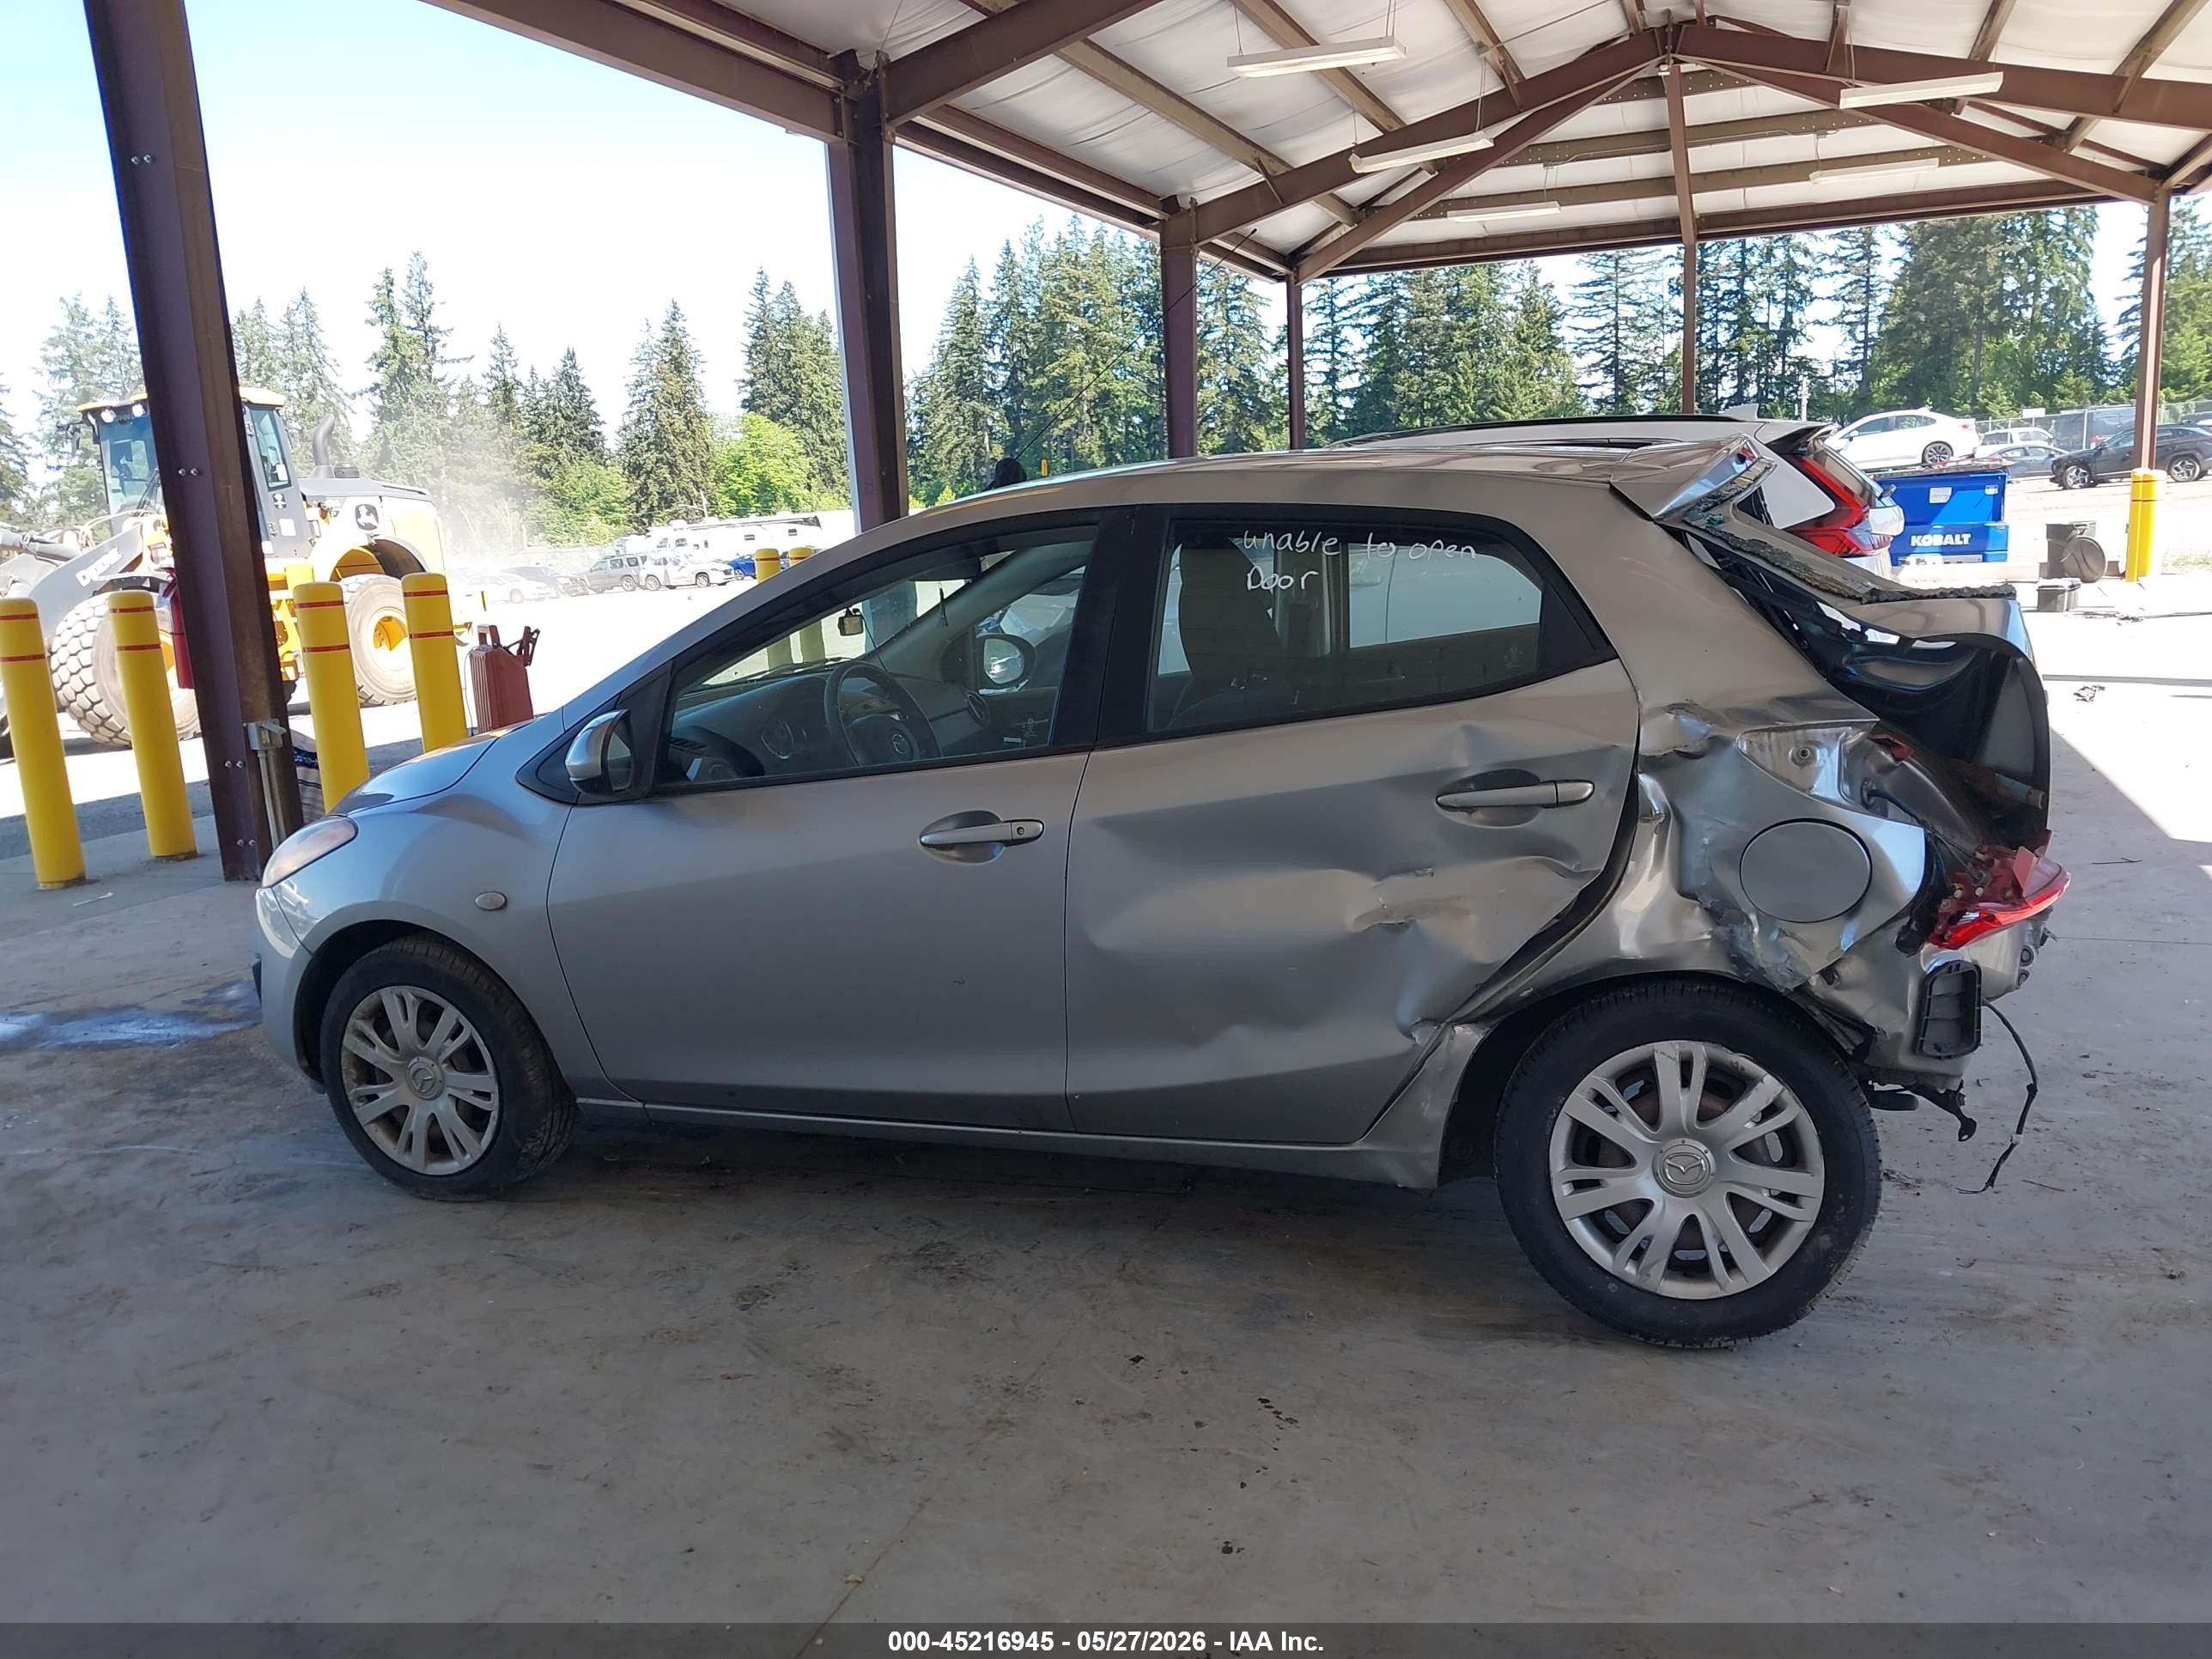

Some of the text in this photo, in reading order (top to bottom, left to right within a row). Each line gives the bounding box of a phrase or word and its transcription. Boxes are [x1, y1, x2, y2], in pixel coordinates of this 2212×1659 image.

[1364, 532, 1396, 559] to
[1408, 539, 1476, 560] open
[1911, 533, 1972, 546] KOBALT
[1247, 565, 1319, 592] Door
